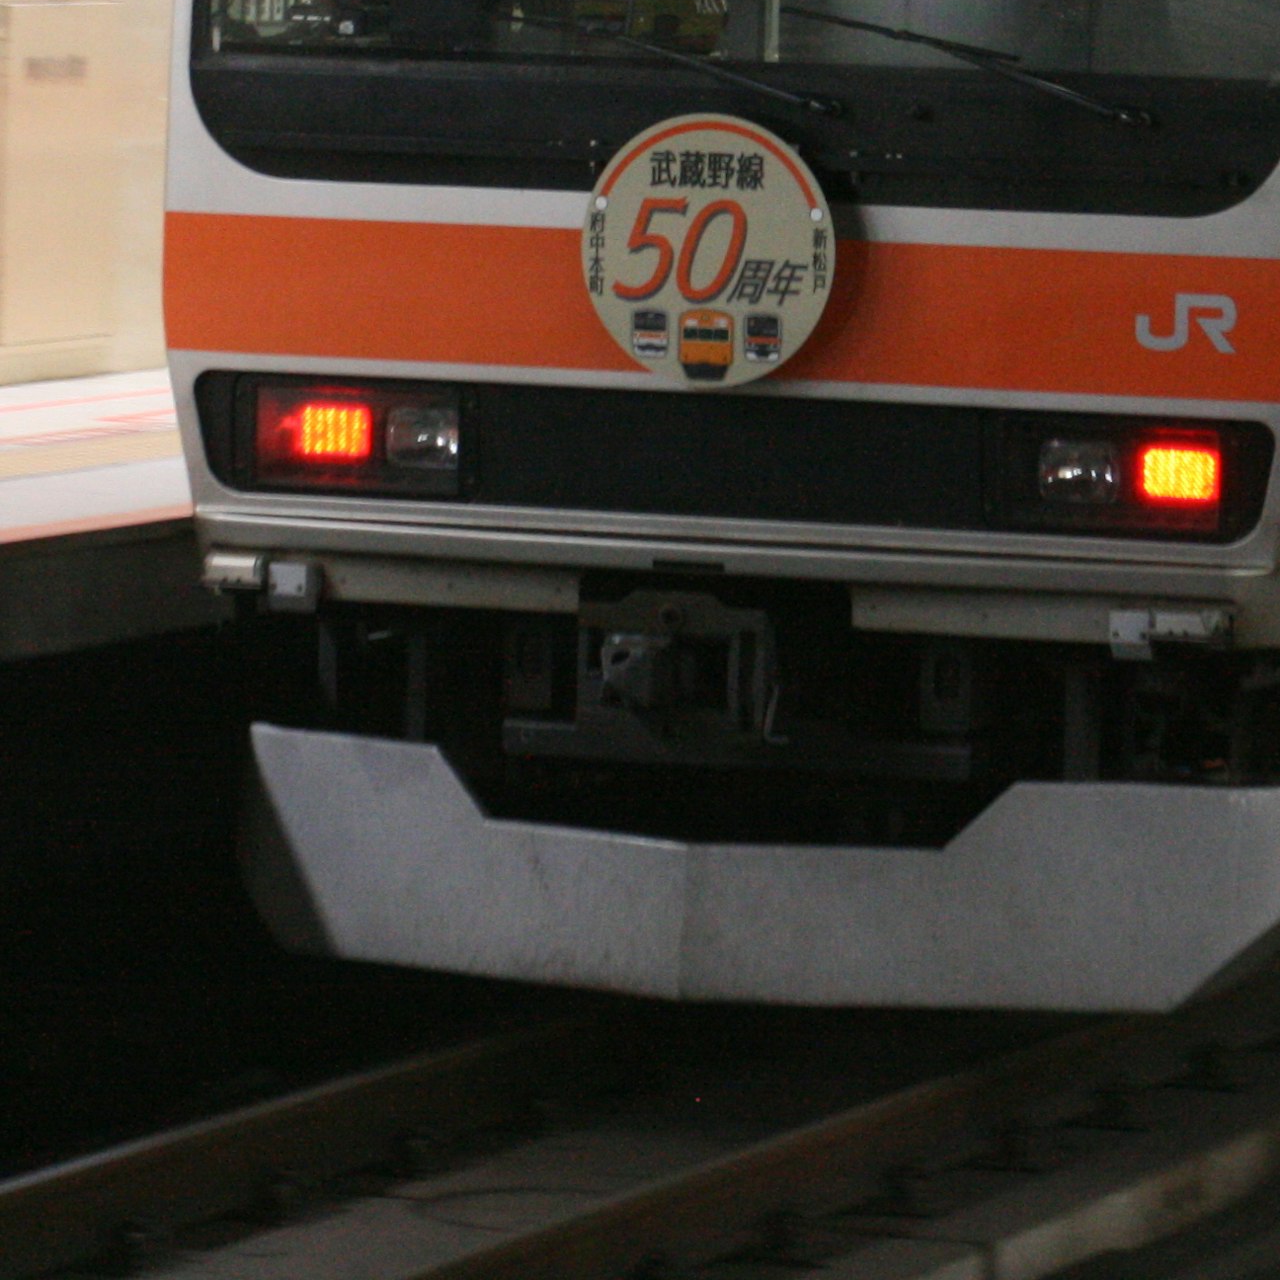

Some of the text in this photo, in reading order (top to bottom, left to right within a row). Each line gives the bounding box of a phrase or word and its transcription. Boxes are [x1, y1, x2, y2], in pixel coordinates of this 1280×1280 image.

[650, 150, 766, 190] 武蔵野線
[1135, 292, 1238, 355] JR
